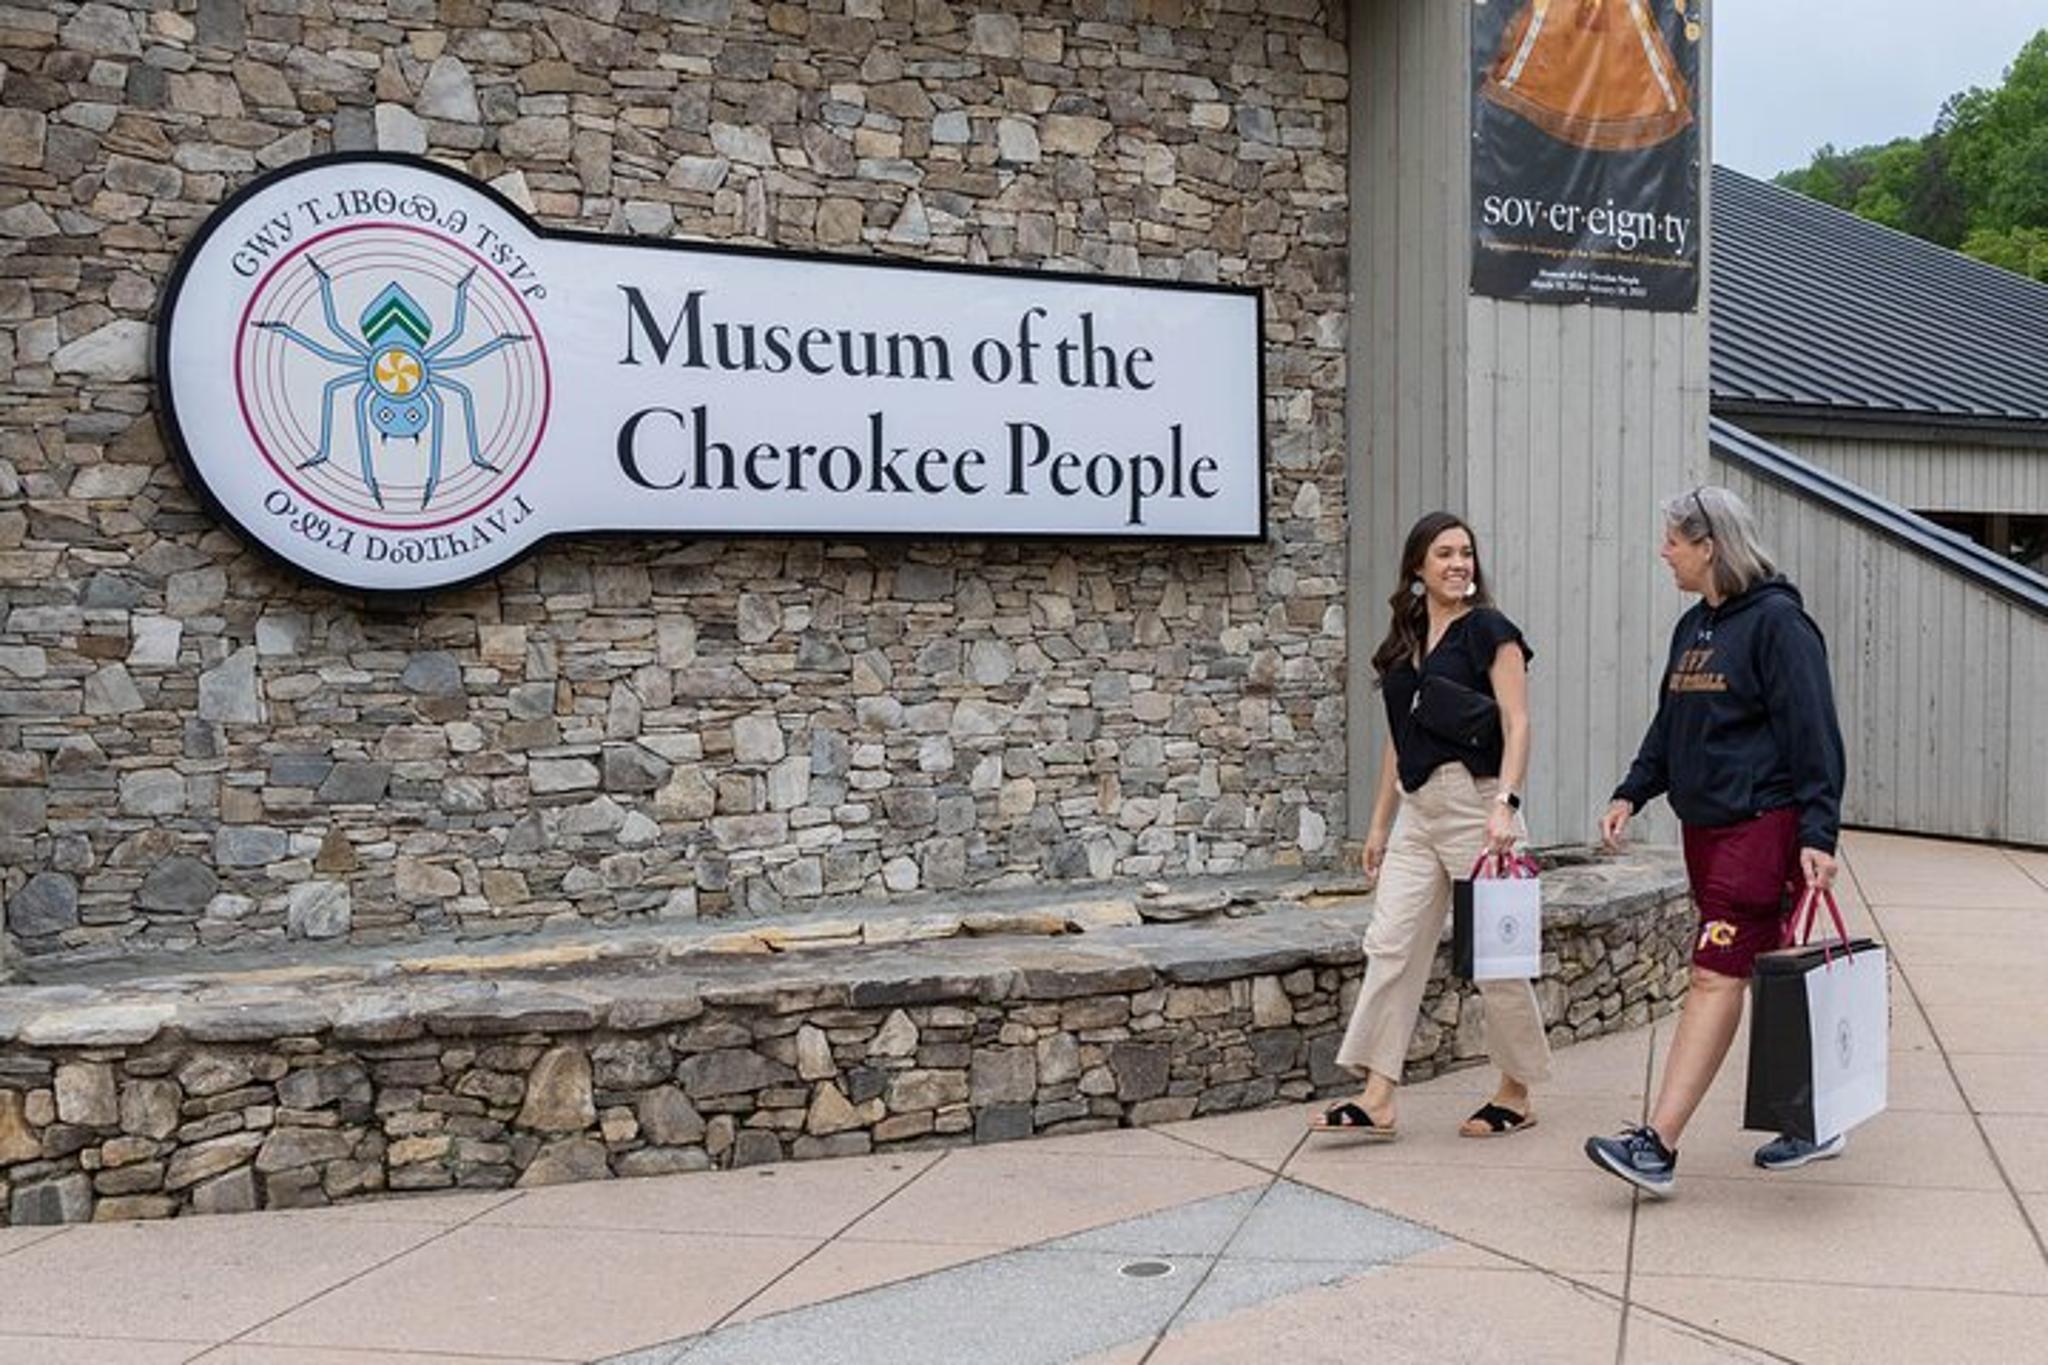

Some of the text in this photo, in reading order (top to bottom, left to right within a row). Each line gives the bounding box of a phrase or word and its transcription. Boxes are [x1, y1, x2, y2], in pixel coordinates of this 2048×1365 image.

[618, 284, 1153, 391] Museum of the
[616, 404, 1219, 525] Cherokee People
